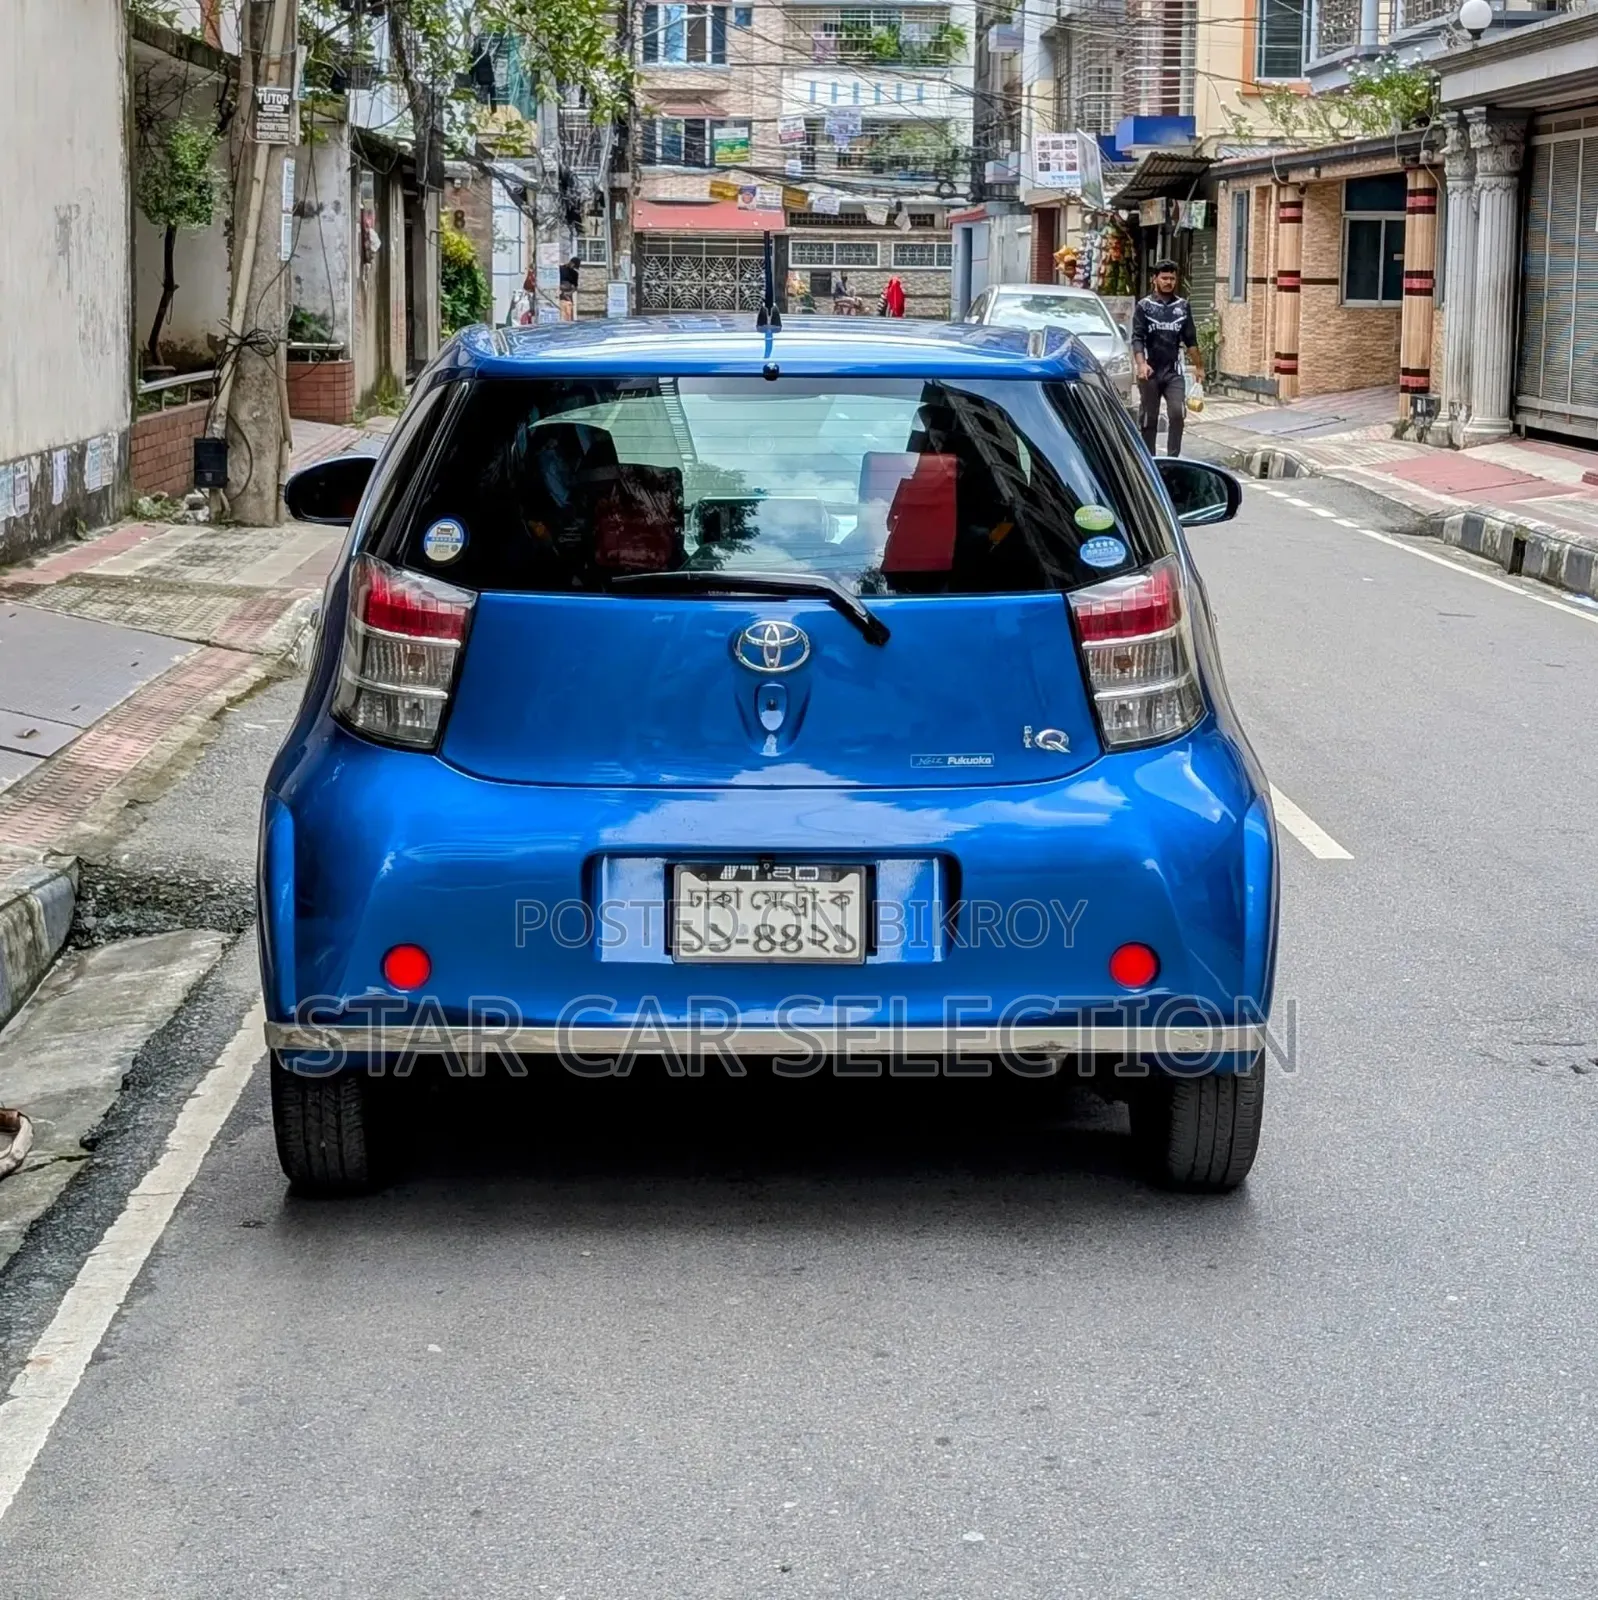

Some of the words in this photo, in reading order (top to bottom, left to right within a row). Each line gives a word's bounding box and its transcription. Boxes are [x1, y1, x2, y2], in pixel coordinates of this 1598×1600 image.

[258, 92, 290, 105] TUTOR
[454, 209, 465, 229] 8
[947, 755, 992, 766] Fukuoka
[687, 886, 744, 910] ঢাকা
[681, 923, 857, 954] ১১-৪৪২১
